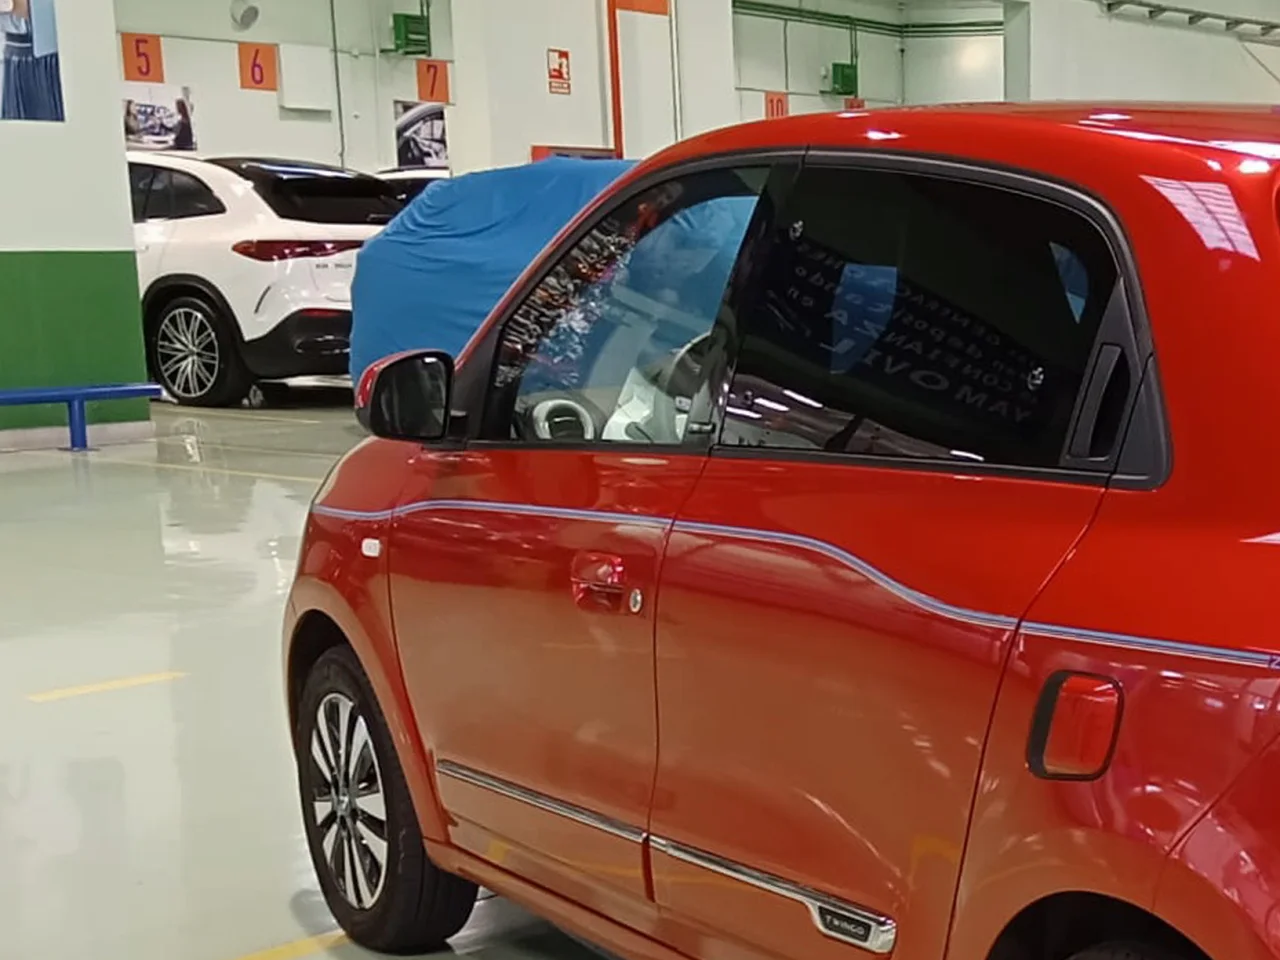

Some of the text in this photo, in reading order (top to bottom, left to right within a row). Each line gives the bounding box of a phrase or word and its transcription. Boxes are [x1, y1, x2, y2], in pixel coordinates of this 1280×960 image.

[134, 38, 150, 76] 5
[251, 48, 264, 85] 6
[425, 64, 439, 99] 7
[768, 98, 785, 118] 10
